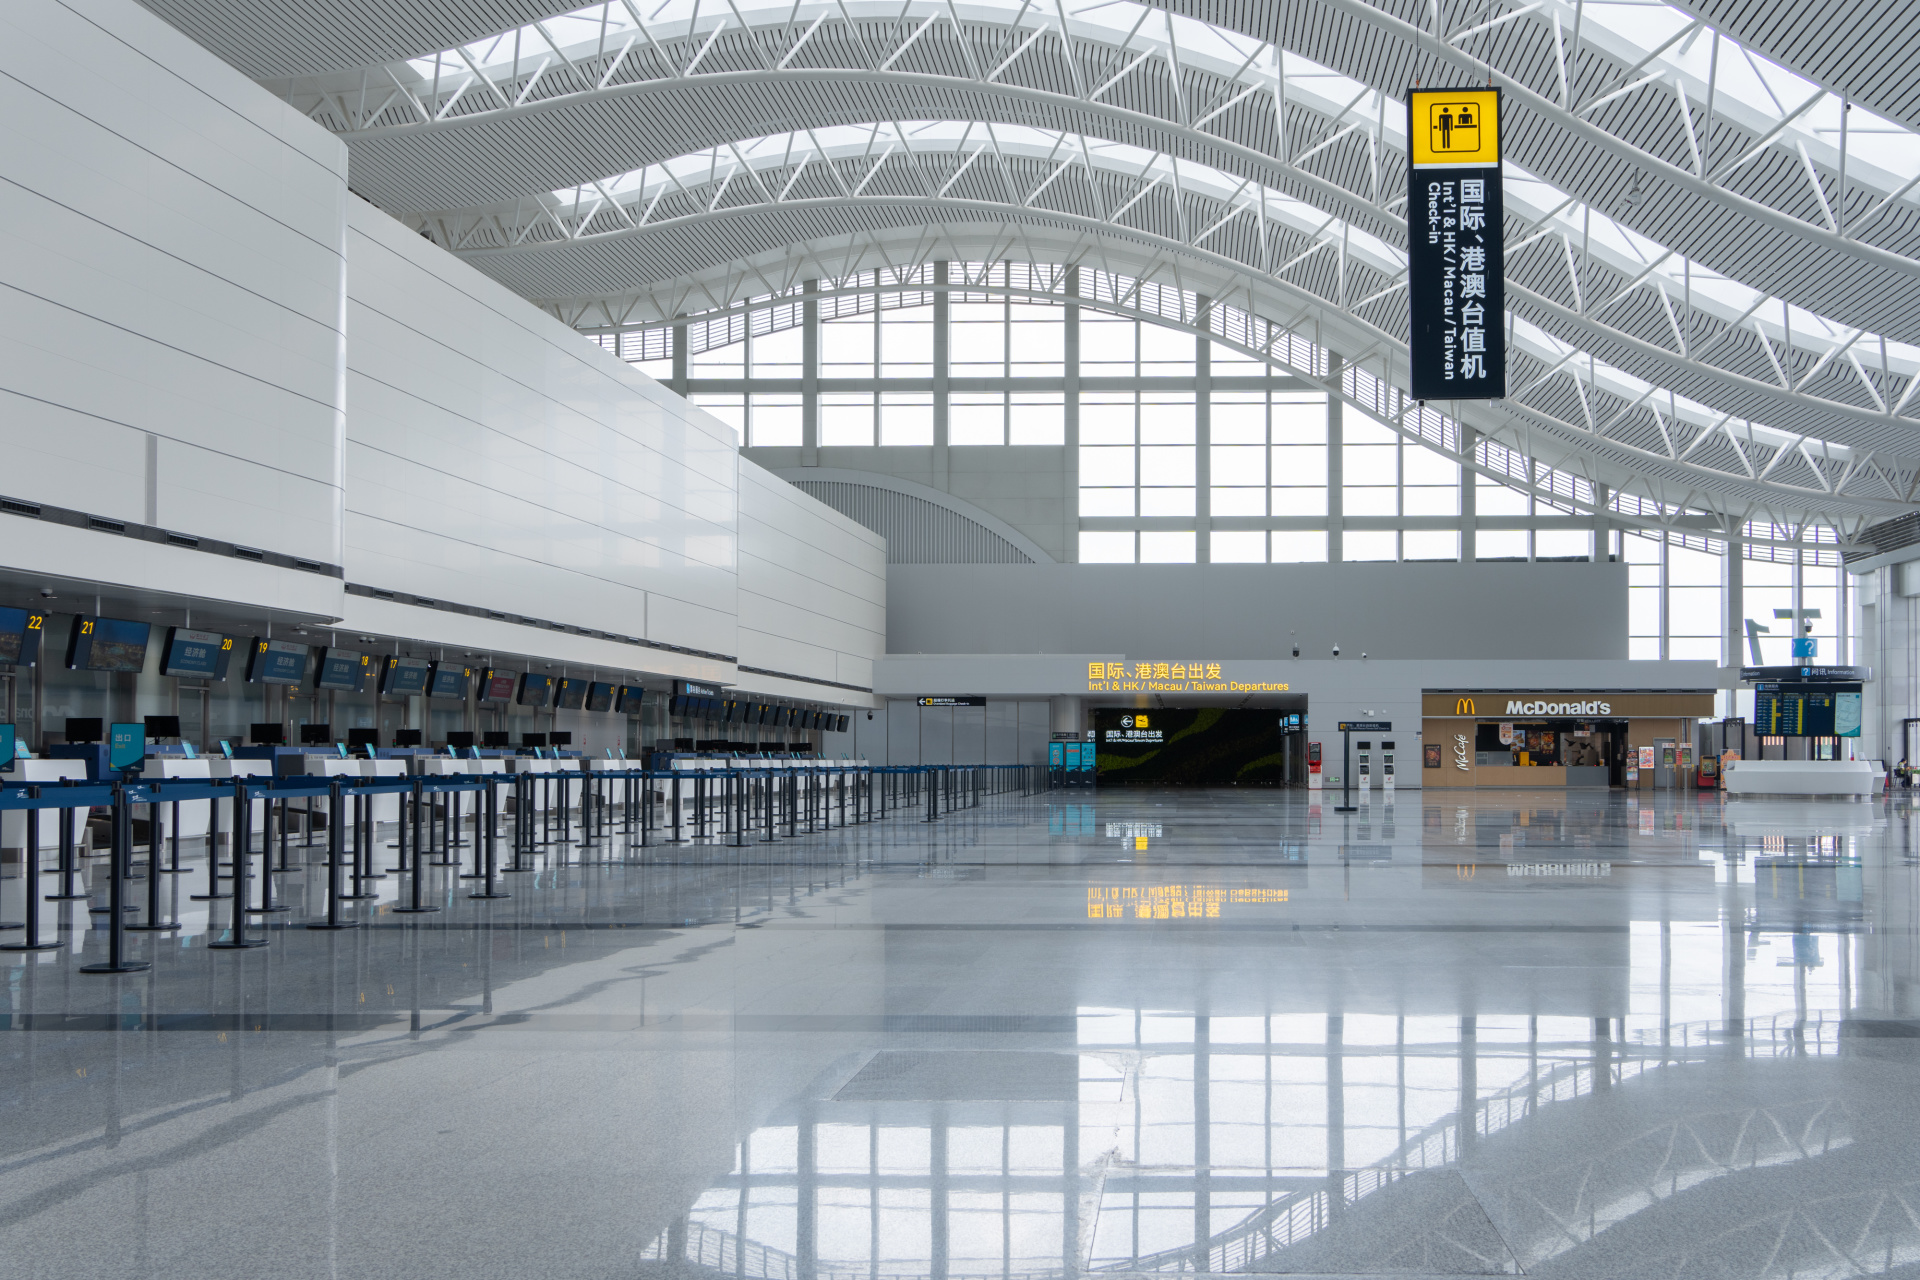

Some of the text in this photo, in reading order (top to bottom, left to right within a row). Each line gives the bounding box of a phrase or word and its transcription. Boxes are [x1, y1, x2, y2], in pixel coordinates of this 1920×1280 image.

[1442, 181, 1456, 213] Int'l
[1428, 182, 1441, 244] Check-in
[1443, 218, 1456, 228] &
[1443, 232, 1456, 254] HK
[1460, 179, 1486, 380] 国际、港澳台值机
[1444, 267, 1456, 316] Macau
[1444, 327, 1456, 380] Taiwan
[28, 615, 42, 630] 22
[81, 621, 94, 635] 21
[222, 638, 232, 650] 20
[258, 642, 268, 654] 19
[184, 647, 206, 658] 经济舱
[361, 655, 369, 666] 18
[390, 659, 398, 668] 17
[464, 668, 470, 677] 16
[487, 670, 493, 679] 15
[1088, 662, 1222, 679] 国际、港澳台出发
[1088, 681, 1109, 691] Int'l
[1112, 682, 1120, 691] &
[1123, 682, 1139, 691] HK
[1149, 682, 1182, 691] Macau
[1191, 682, 1227, 691] Taiwan
[1230, 681, 1289, 692] Departures
[1506, 700, 1611, 715] McDonald's
[1106, 730, 1163, 738] 国际、港澳台出发
[1454, 734, 1470, 771] McCafé
